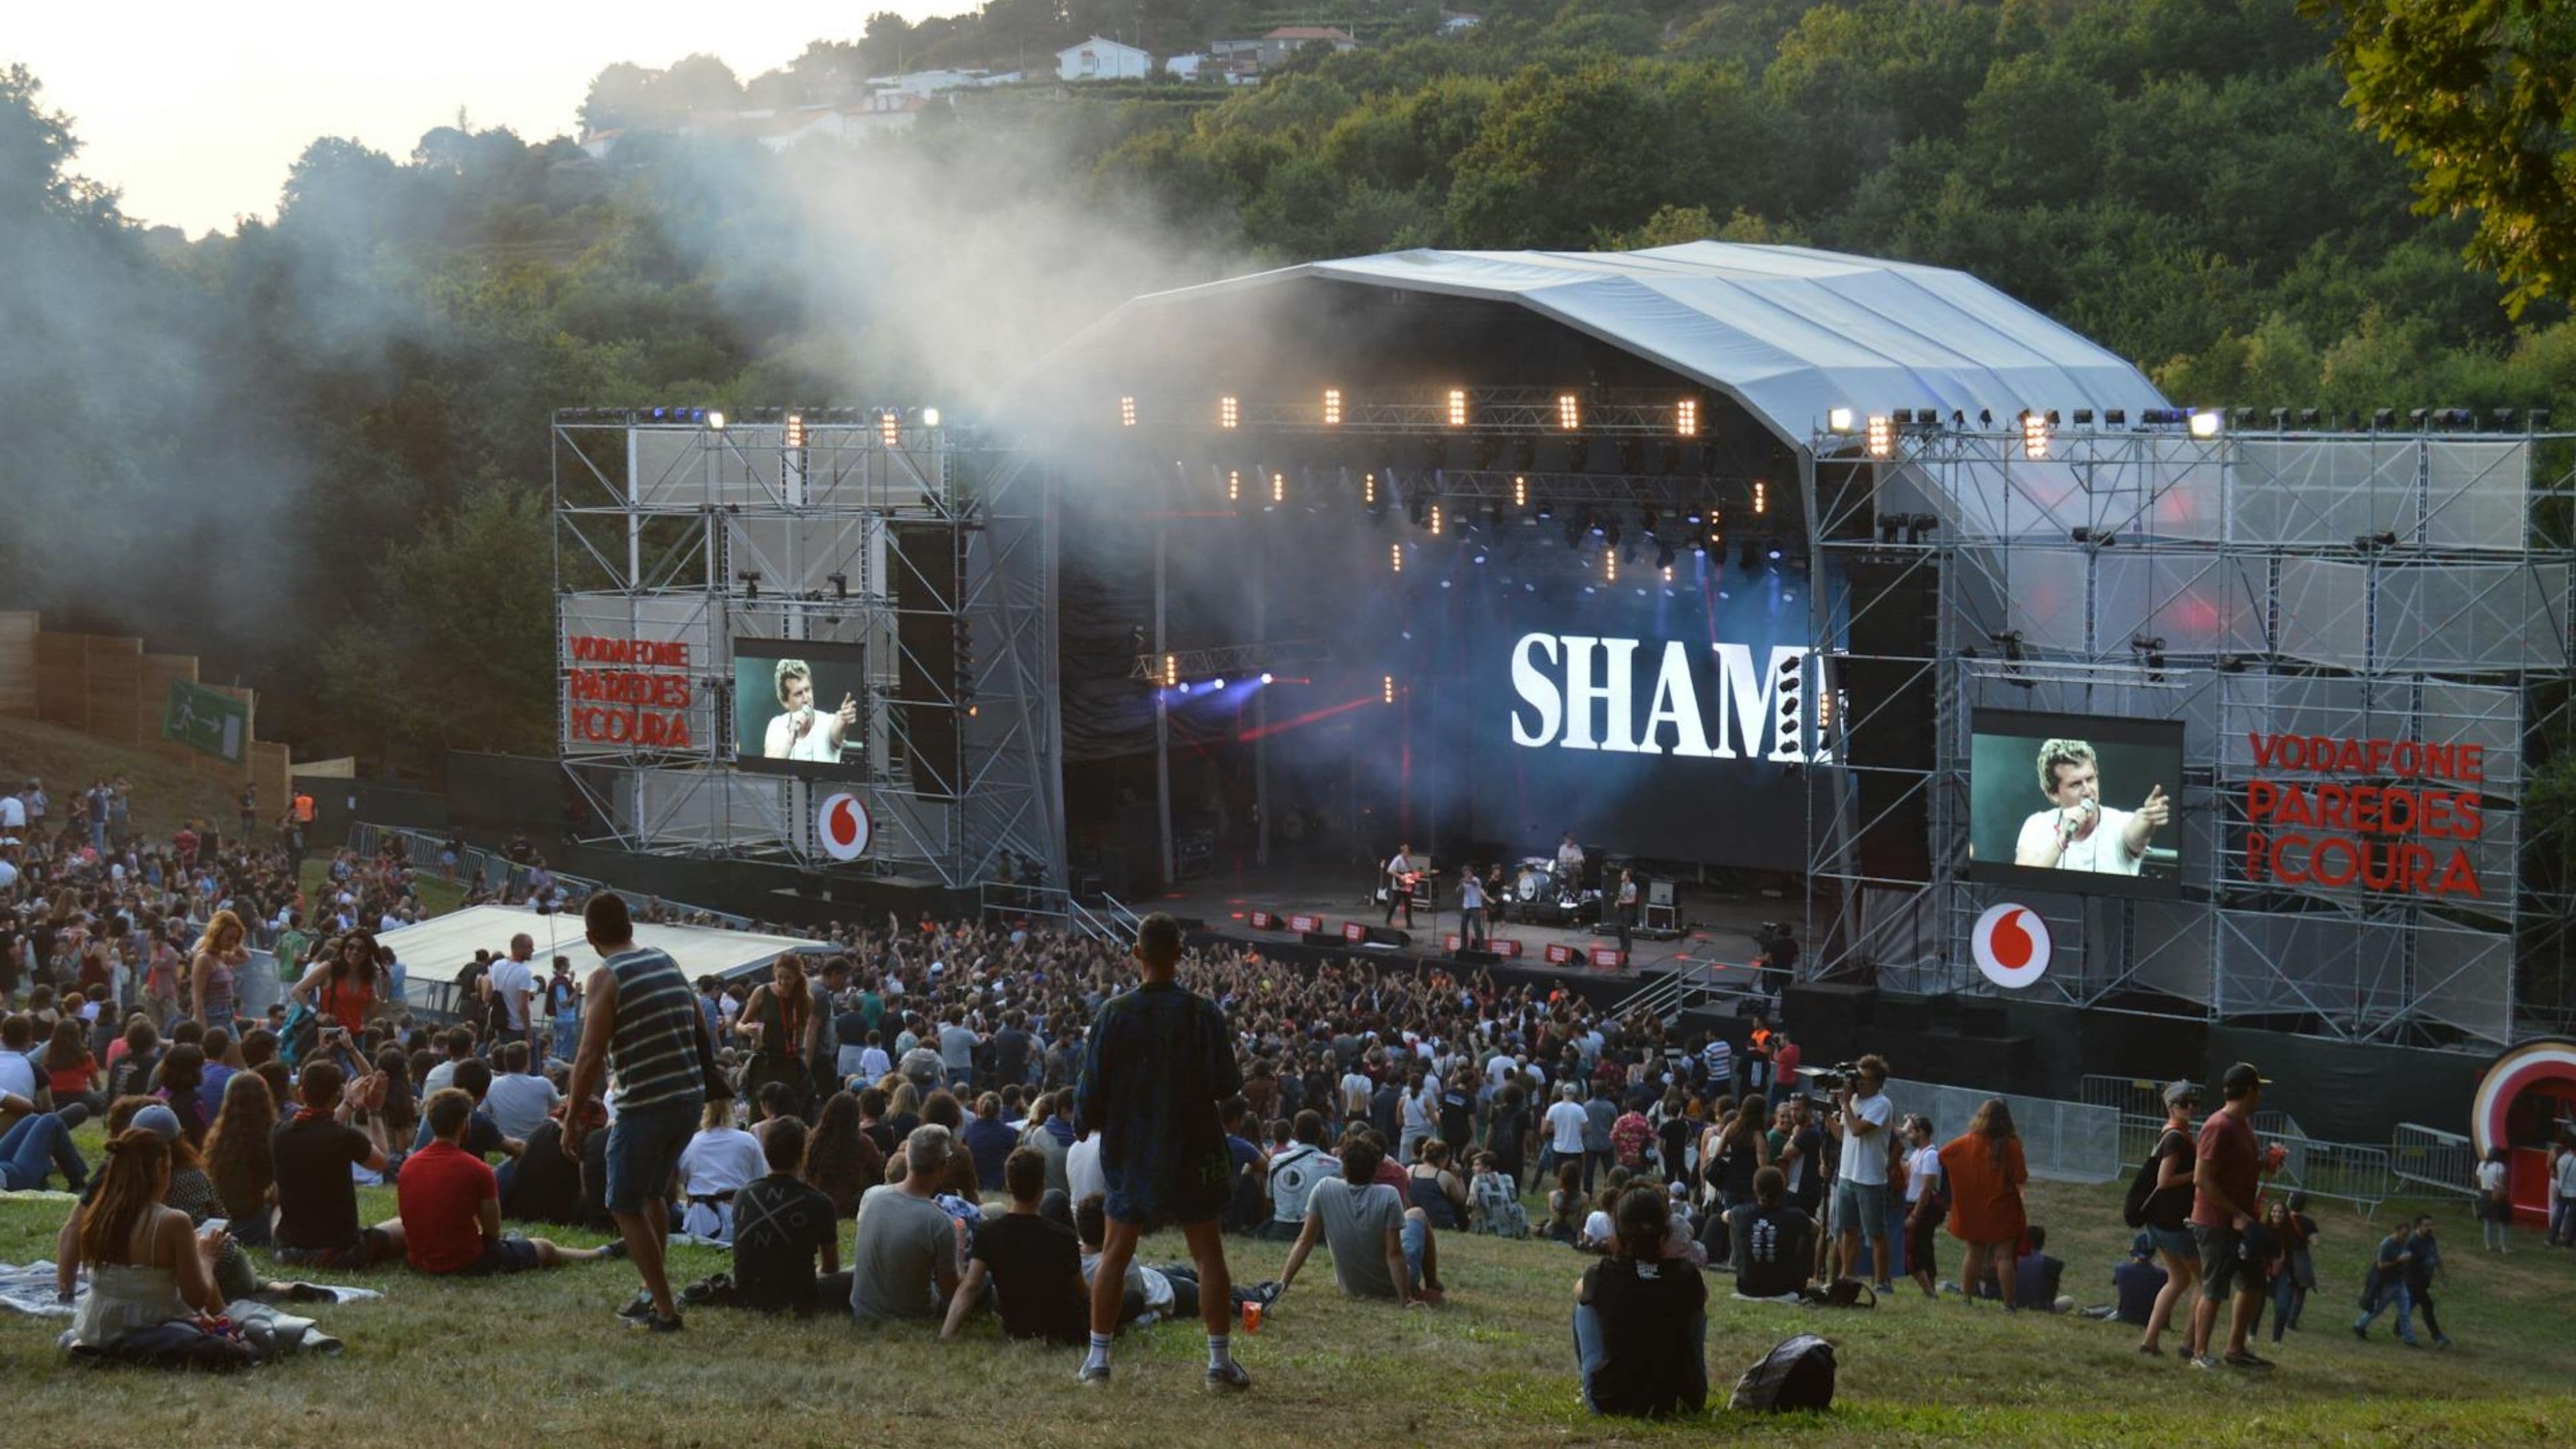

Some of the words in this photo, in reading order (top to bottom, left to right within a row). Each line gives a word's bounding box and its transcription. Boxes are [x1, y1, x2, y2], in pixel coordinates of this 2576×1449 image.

[570, 635, 689, 666] VODAFONE
[570, 668, 690, 708] PAREDES
[1511, 632, 1847, 765] SHAM
[584, 707, 692, 748] COURA
[2248, 731, 2484, 782] VODAFONE
[2247, 779, 2483, 840] PAREDES
[2270, 834, 2483, 899] COURA
